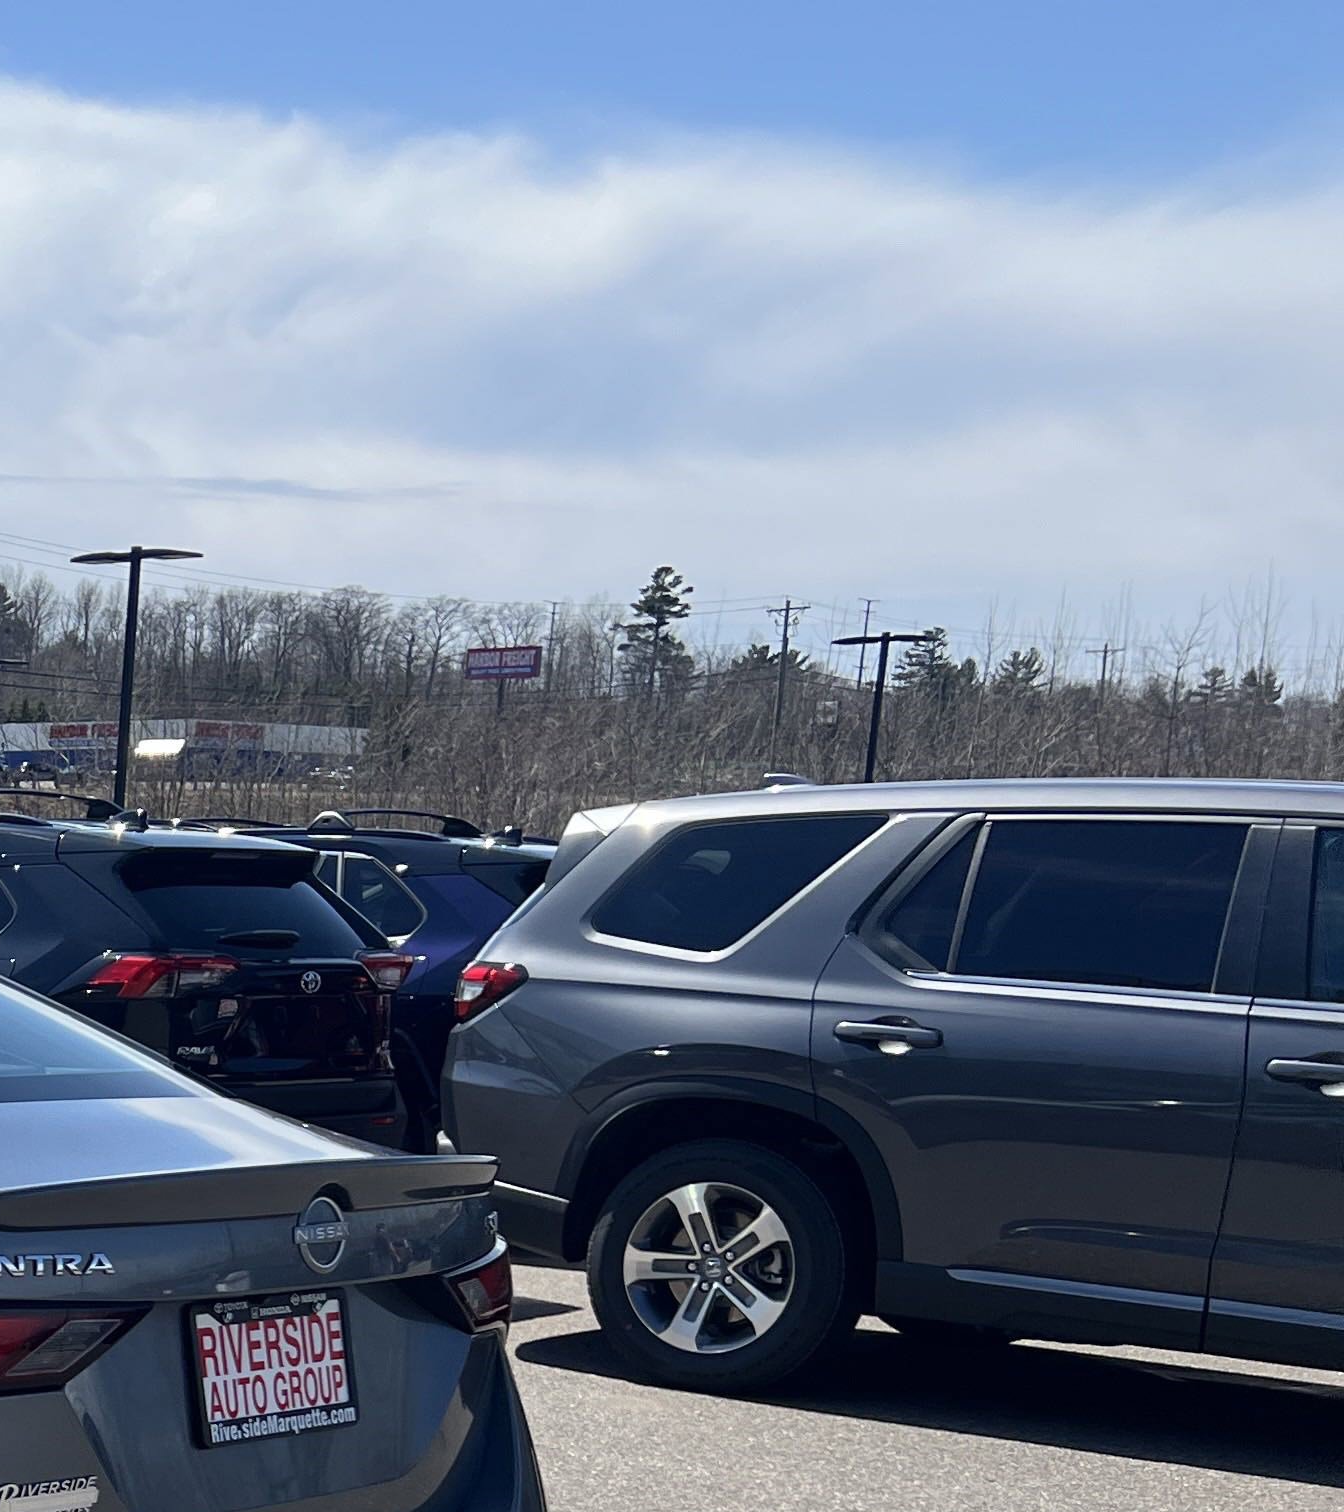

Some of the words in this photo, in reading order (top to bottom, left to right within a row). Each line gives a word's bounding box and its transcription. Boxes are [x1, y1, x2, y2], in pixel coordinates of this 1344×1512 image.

[197, 1311, 346, 1378] RIVERSIDE
[211, 1375, 268, 1421] AUTO
[273, 1364, 344, 1412] GROUP
